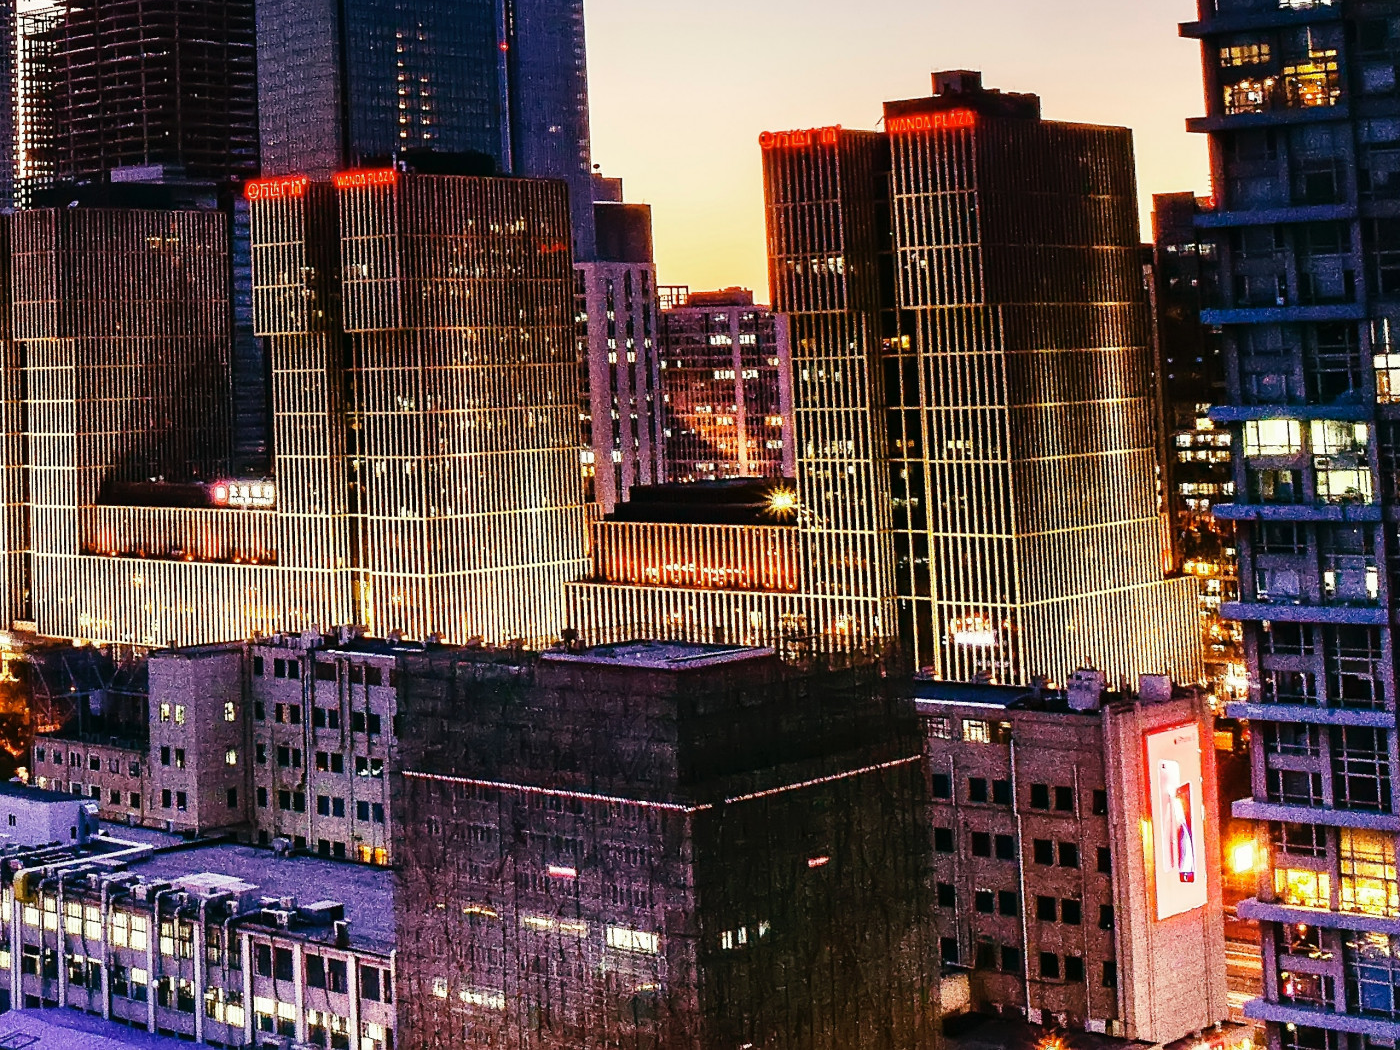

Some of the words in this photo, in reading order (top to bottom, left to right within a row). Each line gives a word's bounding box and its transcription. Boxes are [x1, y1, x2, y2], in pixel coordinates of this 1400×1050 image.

[888, 116, 931, 131] WANDA
[934, 110, 974, 128] PLAZA
[336, 173, 366, 186] WANDA
[368, 170, 395, 183] PLAZA
